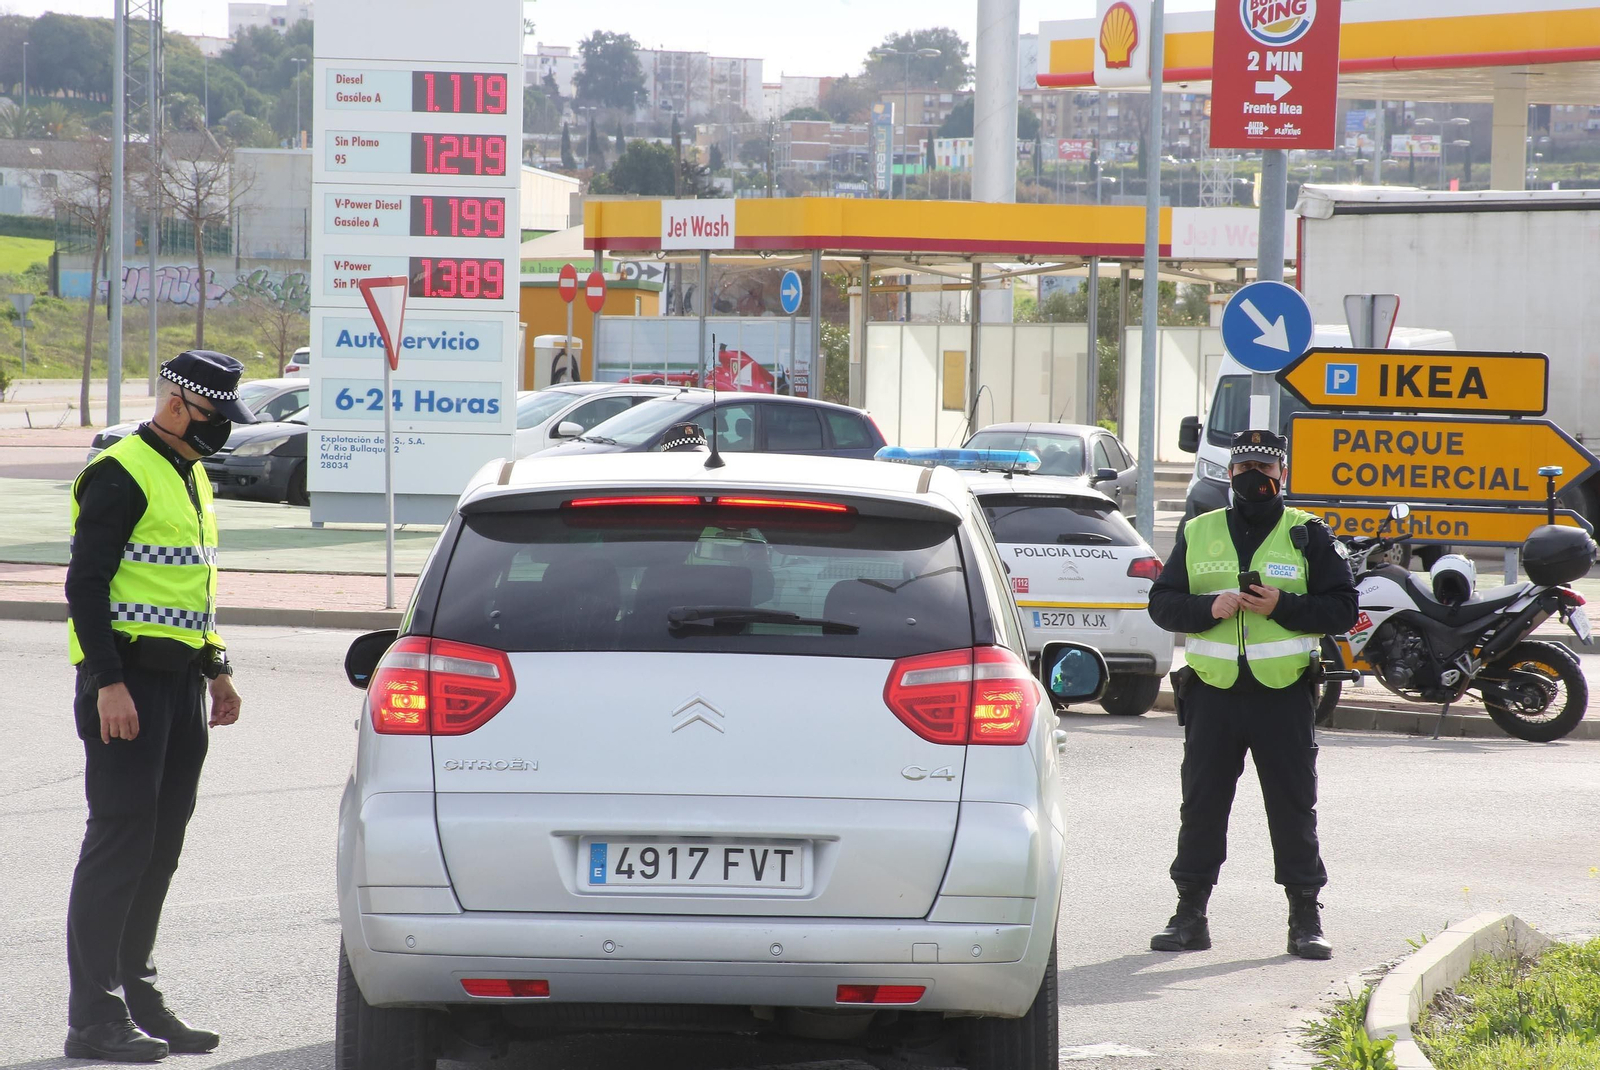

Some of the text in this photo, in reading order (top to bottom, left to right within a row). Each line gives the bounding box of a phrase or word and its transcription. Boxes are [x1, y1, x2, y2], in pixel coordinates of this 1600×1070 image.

[1252, 0, 1307, 29] KING
[1247, 51, 1303, 72] 2 MIN
[336, 74, 363, 84] Diesel
[336, 92, 382, 103] Gasóleo A
[425, 73, 506, 113] 1.119
[1243, 102, 1303, 114] Frente Ikea
[335, 136, 380, 147] Sin Plomo
[335, 154, 347, 165] 95
[423, 135, 505, 175] 1.249
[335, 199, 402, 210] V-Power Diesel
[334, 217, 379, 228] Gasóleo A
[423, 198, 504, 237] 1.199
[667, 214, 729, 238] Jet Wash
[1183, 223, 1218, 246] Jet
[334, 261, 371, 271] V-Power
[333, 279, 348, 289] Sin
[421, 259, 503, 298] 1.389
[335, 330, 480, 351] Autoervicio
[1333, 364, 1488, 399] P IKEA
[414, 390, 500, 414] Horas
[321, 435, 371, 446] Explotación
[374, 436, 385, 445] de
[408, 437, 426, 446] S.A.
[1332, 429, 1464, 456] PARQUE
[321, 444, 331, 452] C/
[394, 446, 400, 454] 2
[321, 453, 352, 461] Madrid
[321, 461, 349, 469] 28034
[1331, 462, 1529, 492] COMERCIAL
[1325, 512, 1469, 536] Decathlon
[1014, 547, 1118, 560] POLICIA LOCAL
[1268, 564, 1296, 572] POLICIA
[1017, 579, 1028, 587] 112
[1042, 612, 1075, 627] 5270
[1082, 613, 1107, 628] KJX
[442, 756, 539, 771] CITROËN
[900, 764, 956, 782] C4
[593, 846, 795, 882] E 4917 FVT
